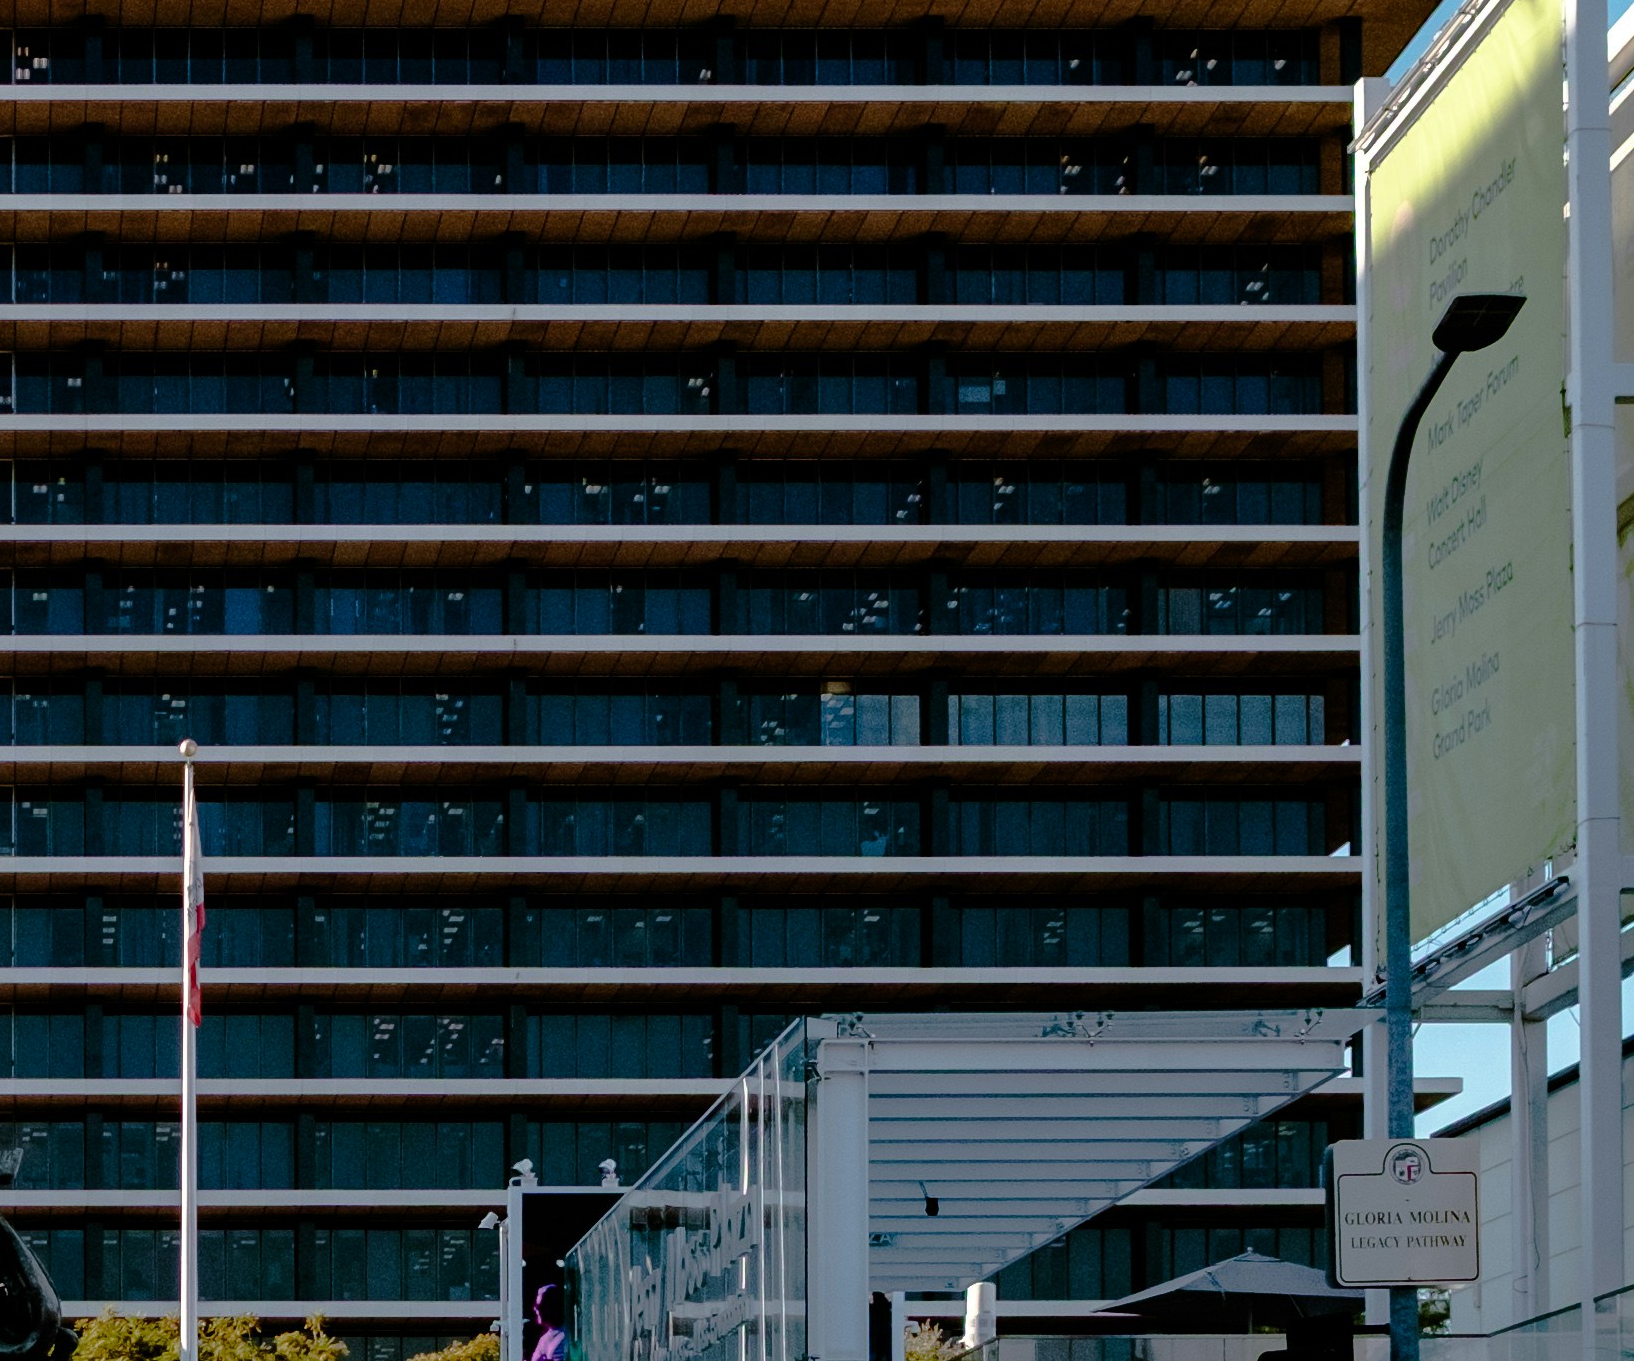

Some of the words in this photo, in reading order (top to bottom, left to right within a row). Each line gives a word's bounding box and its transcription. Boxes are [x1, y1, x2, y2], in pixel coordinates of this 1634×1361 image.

[1429, 209, 1469, 266] Dorothy
[1472, 157, 1516, 221] Chandler
[1429, 258, 1468, 311] Pavilion
[1428, 409, 1454, 453] Mark
[1456, 387, 1484, 431] Taper
[1486, 355, 1518, 401] Forum
[1427, 484, 1449, 524] Walt
[1452, 457, 1483, 499] Disney
[1428, 522, 1465, 570] Concert
[1467, 494, 1486, 540] Hall
[1431, 604, 1457, 644] Jerry
[1459, 585, 1484, 620] Moss
[1486, 560, 1513, 599] Plaza
[1431, 676, 1463, 716] Gloria
[1466, 651, 1499, 695] Molina
[1433, 712, 1464, 760] Grand
[1467, 697, 1491, 737] Park
[1344, 1211, 1403, 1226] GLORIA
[1410, 1209, 1471, 1224] MOLINA
[1351, 1236, 1399, 1249] LEGACY
[1406, 1234, 1467, 1249] PATHWAY
